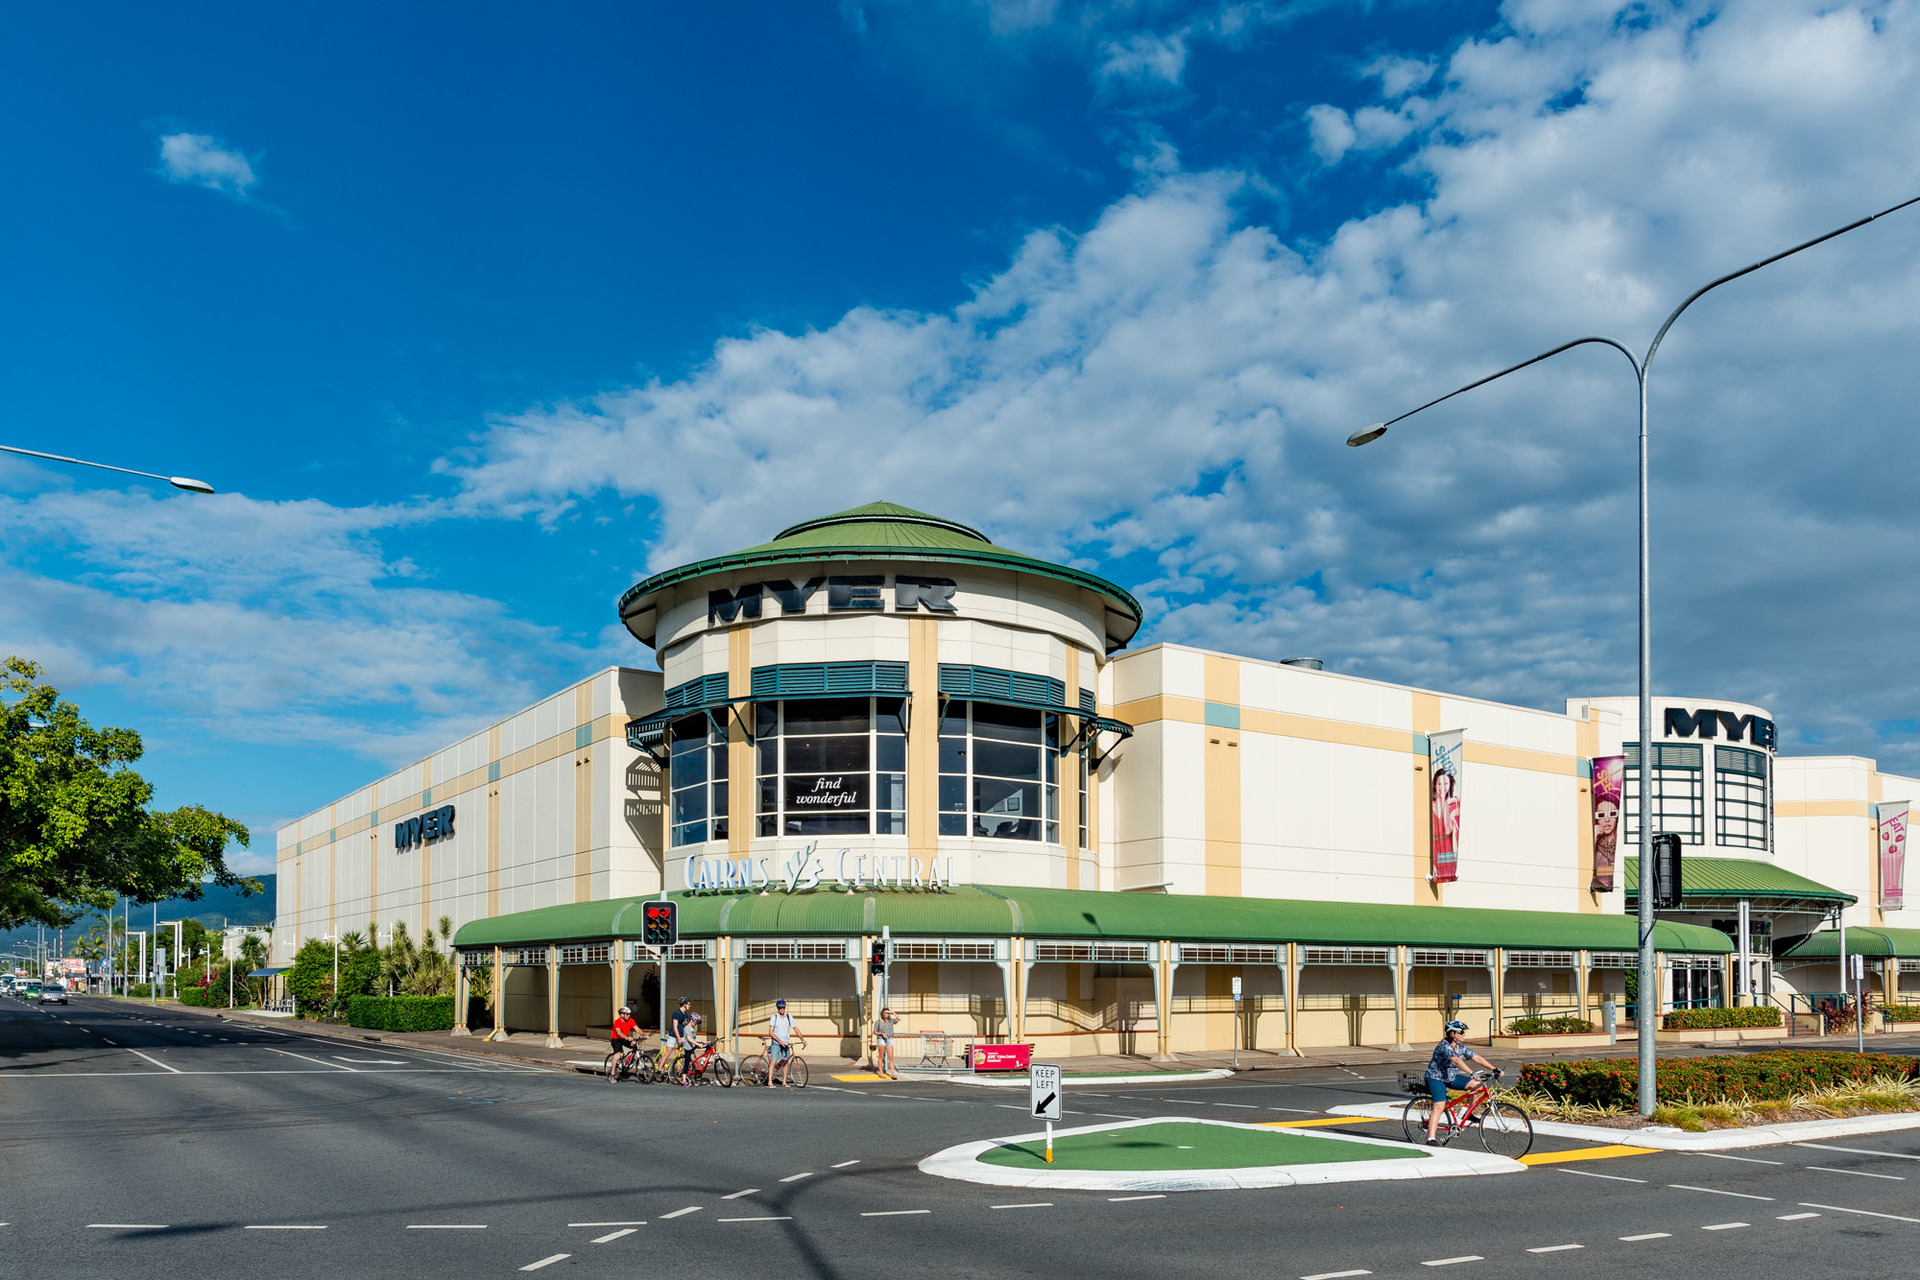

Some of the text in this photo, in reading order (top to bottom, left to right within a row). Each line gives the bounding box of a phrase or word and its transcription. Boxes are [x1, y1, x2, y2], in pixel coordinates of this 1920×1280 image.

[708, 575, 958, 626] MYER
[811, 777, 842, 792] find
[1597, 769, 1613, 792] SEE
[796, 791, 857, 807] wonderful
[395, 805, 455, 848] MYER
[1889, 817, 1904, 833] EAT
[684, 848, 960, 890] CAIRNS CENTRAL
[1712, 919, 1772, 935] MER
[1035, 1069, 1055, 1078] KEEP
[1036, 1080, 1055, 1089] LEFT
